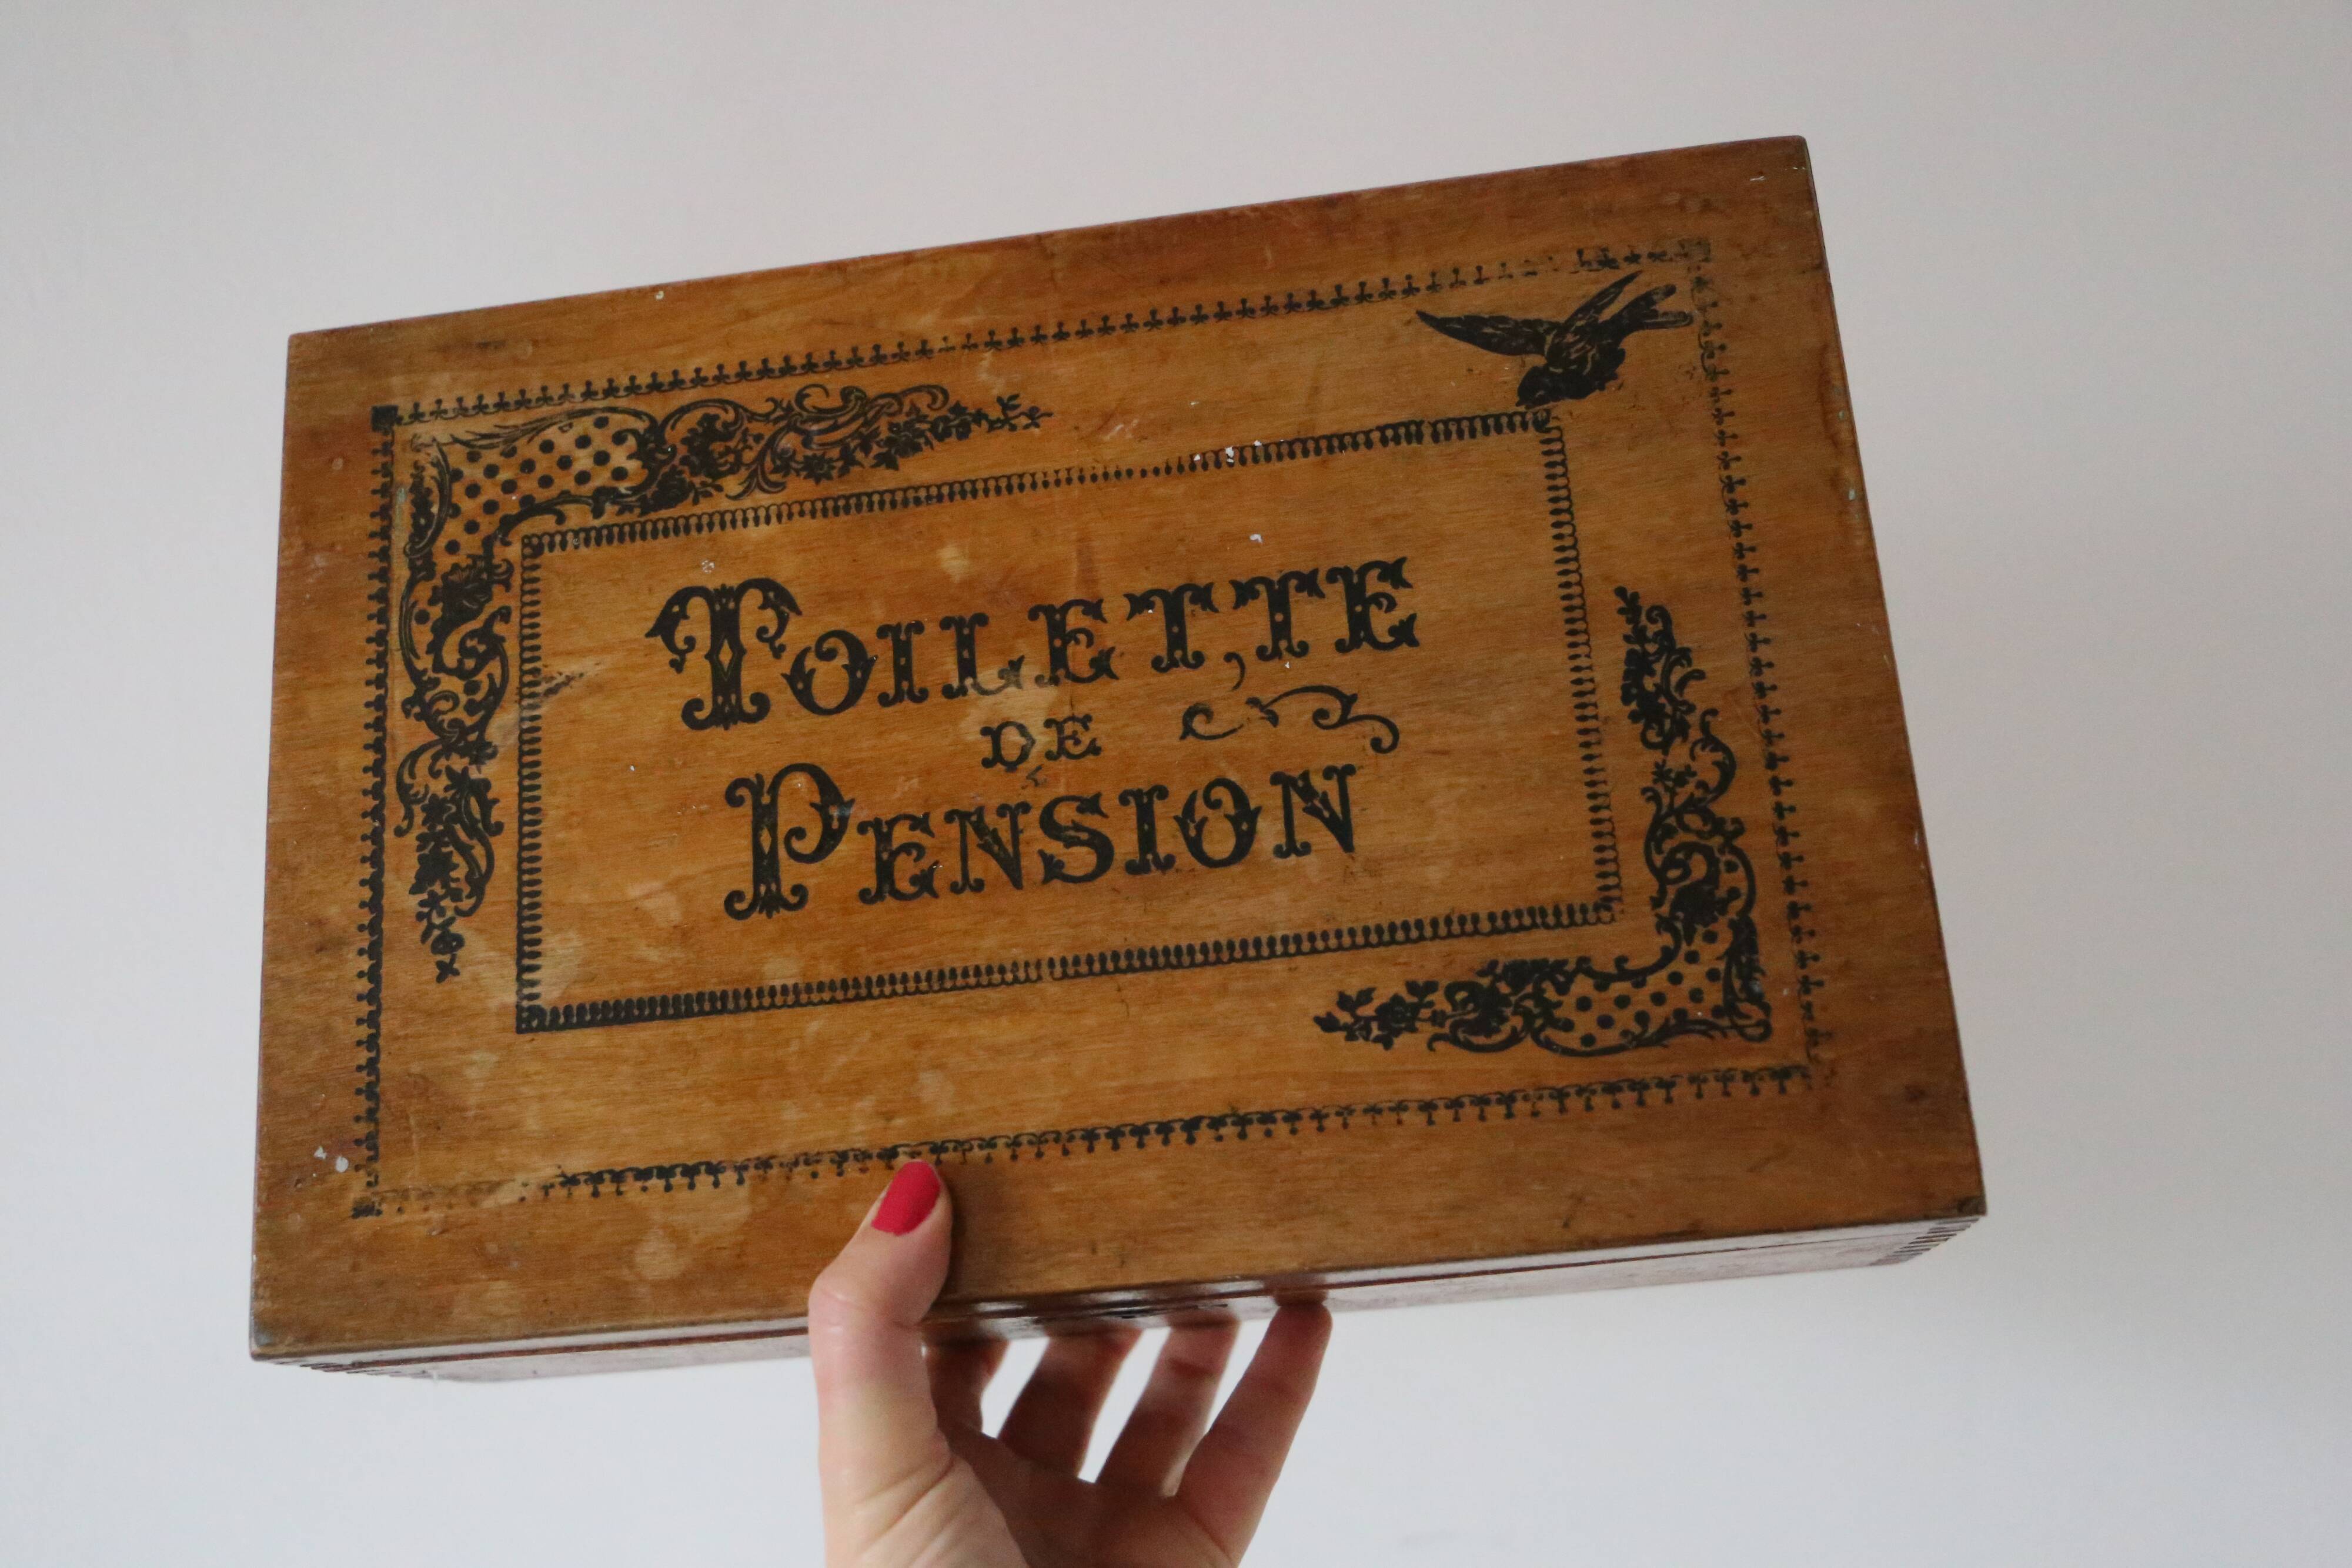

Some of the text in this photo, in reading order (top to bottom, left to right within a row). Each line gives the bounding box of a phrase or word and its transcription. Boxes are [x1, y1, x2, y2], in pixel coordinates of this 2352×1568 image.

[645, 556, 1421, 731] TOILETTE
[980, 713, 1102, 773] DE
[724, 763, 1357, 921] PENSION
